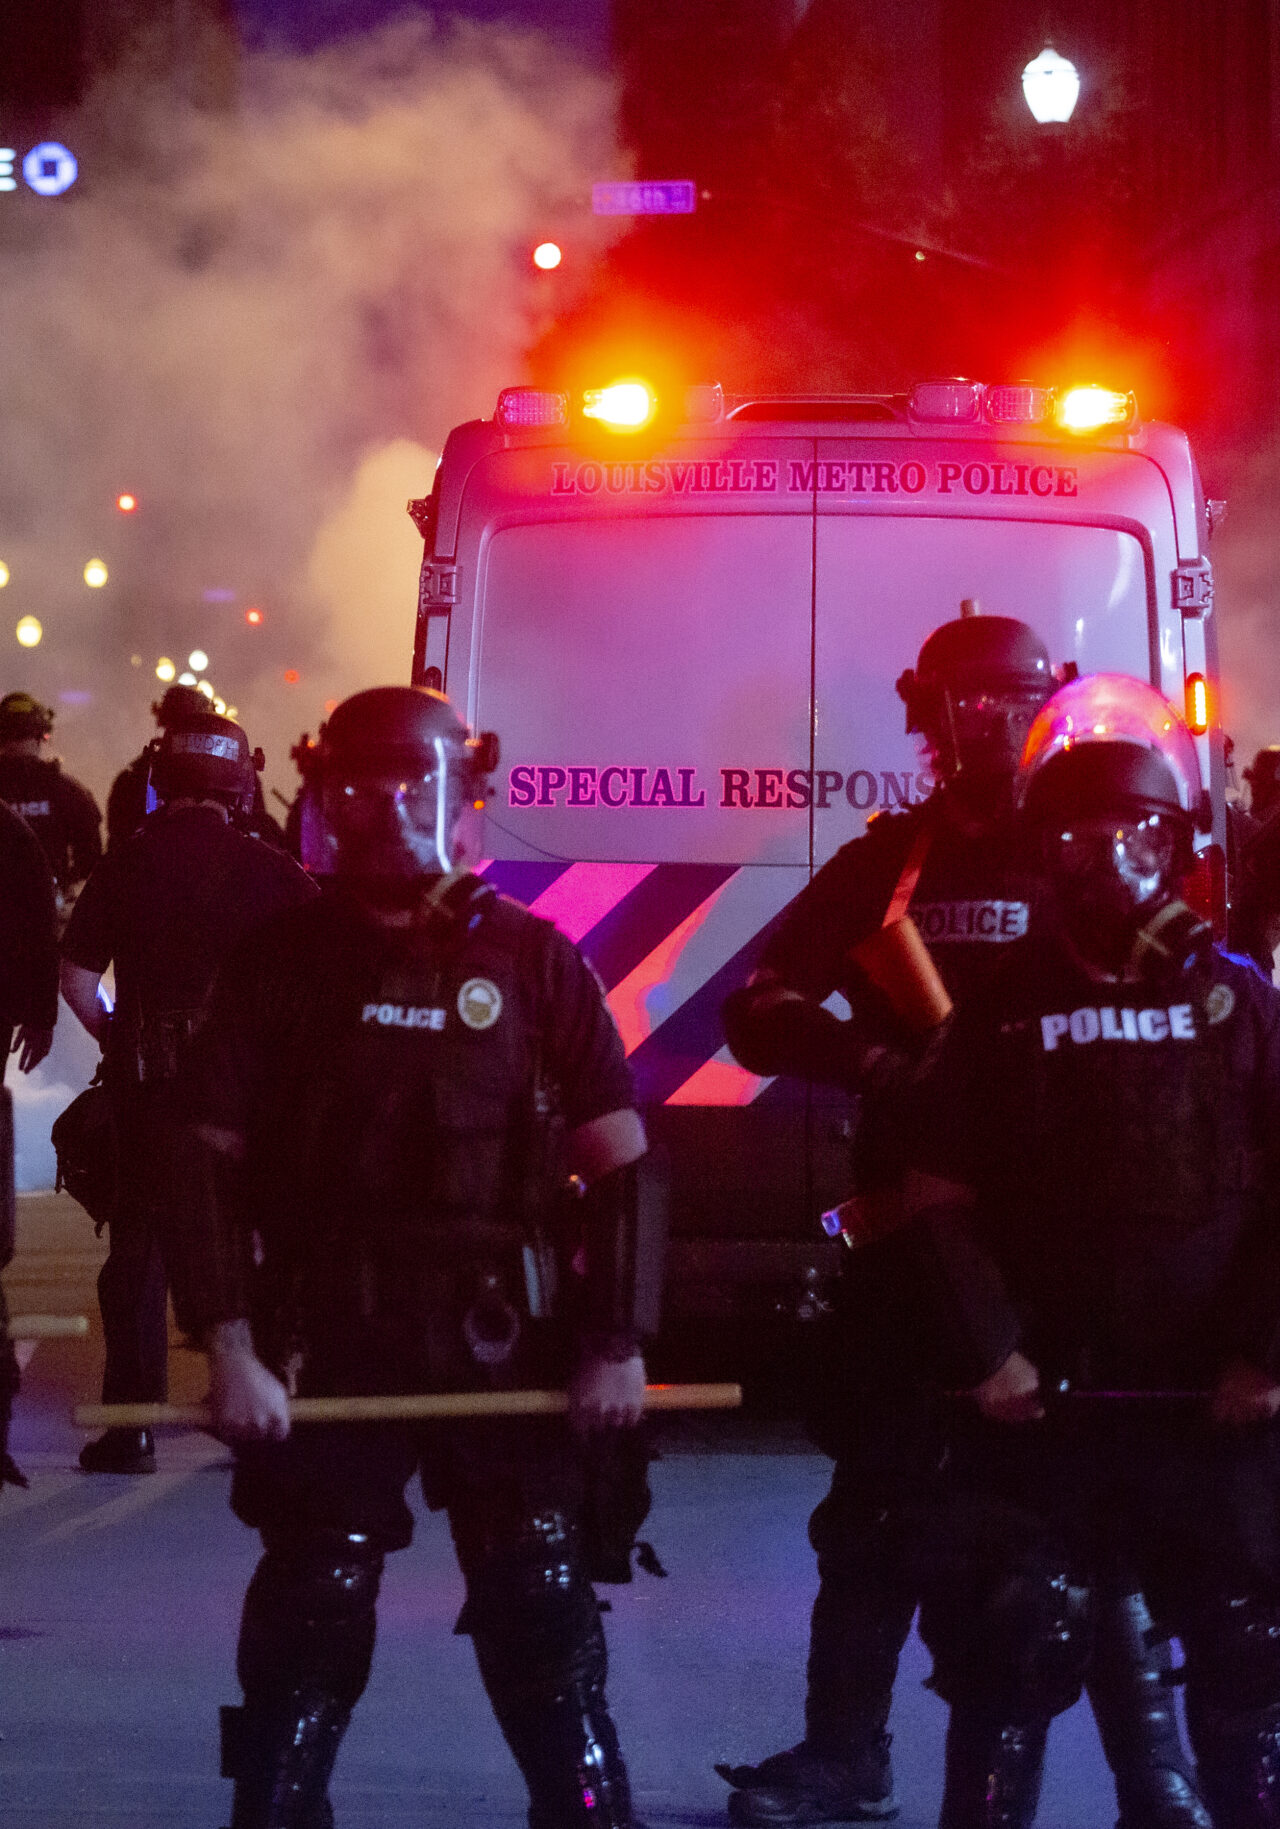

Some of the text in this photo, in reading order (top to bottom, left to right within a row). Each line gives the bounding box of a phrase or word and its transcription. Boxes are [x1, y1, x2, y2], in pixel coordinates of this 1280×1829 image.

[551, 461, 1078, 497] LOUISVILLE METRO POLICE
[509, 765, 706, 808] SPECIAL
[362, 1003, 447, 1031] POLICE
[1040, 1003, 1196, 1050] POLICE
